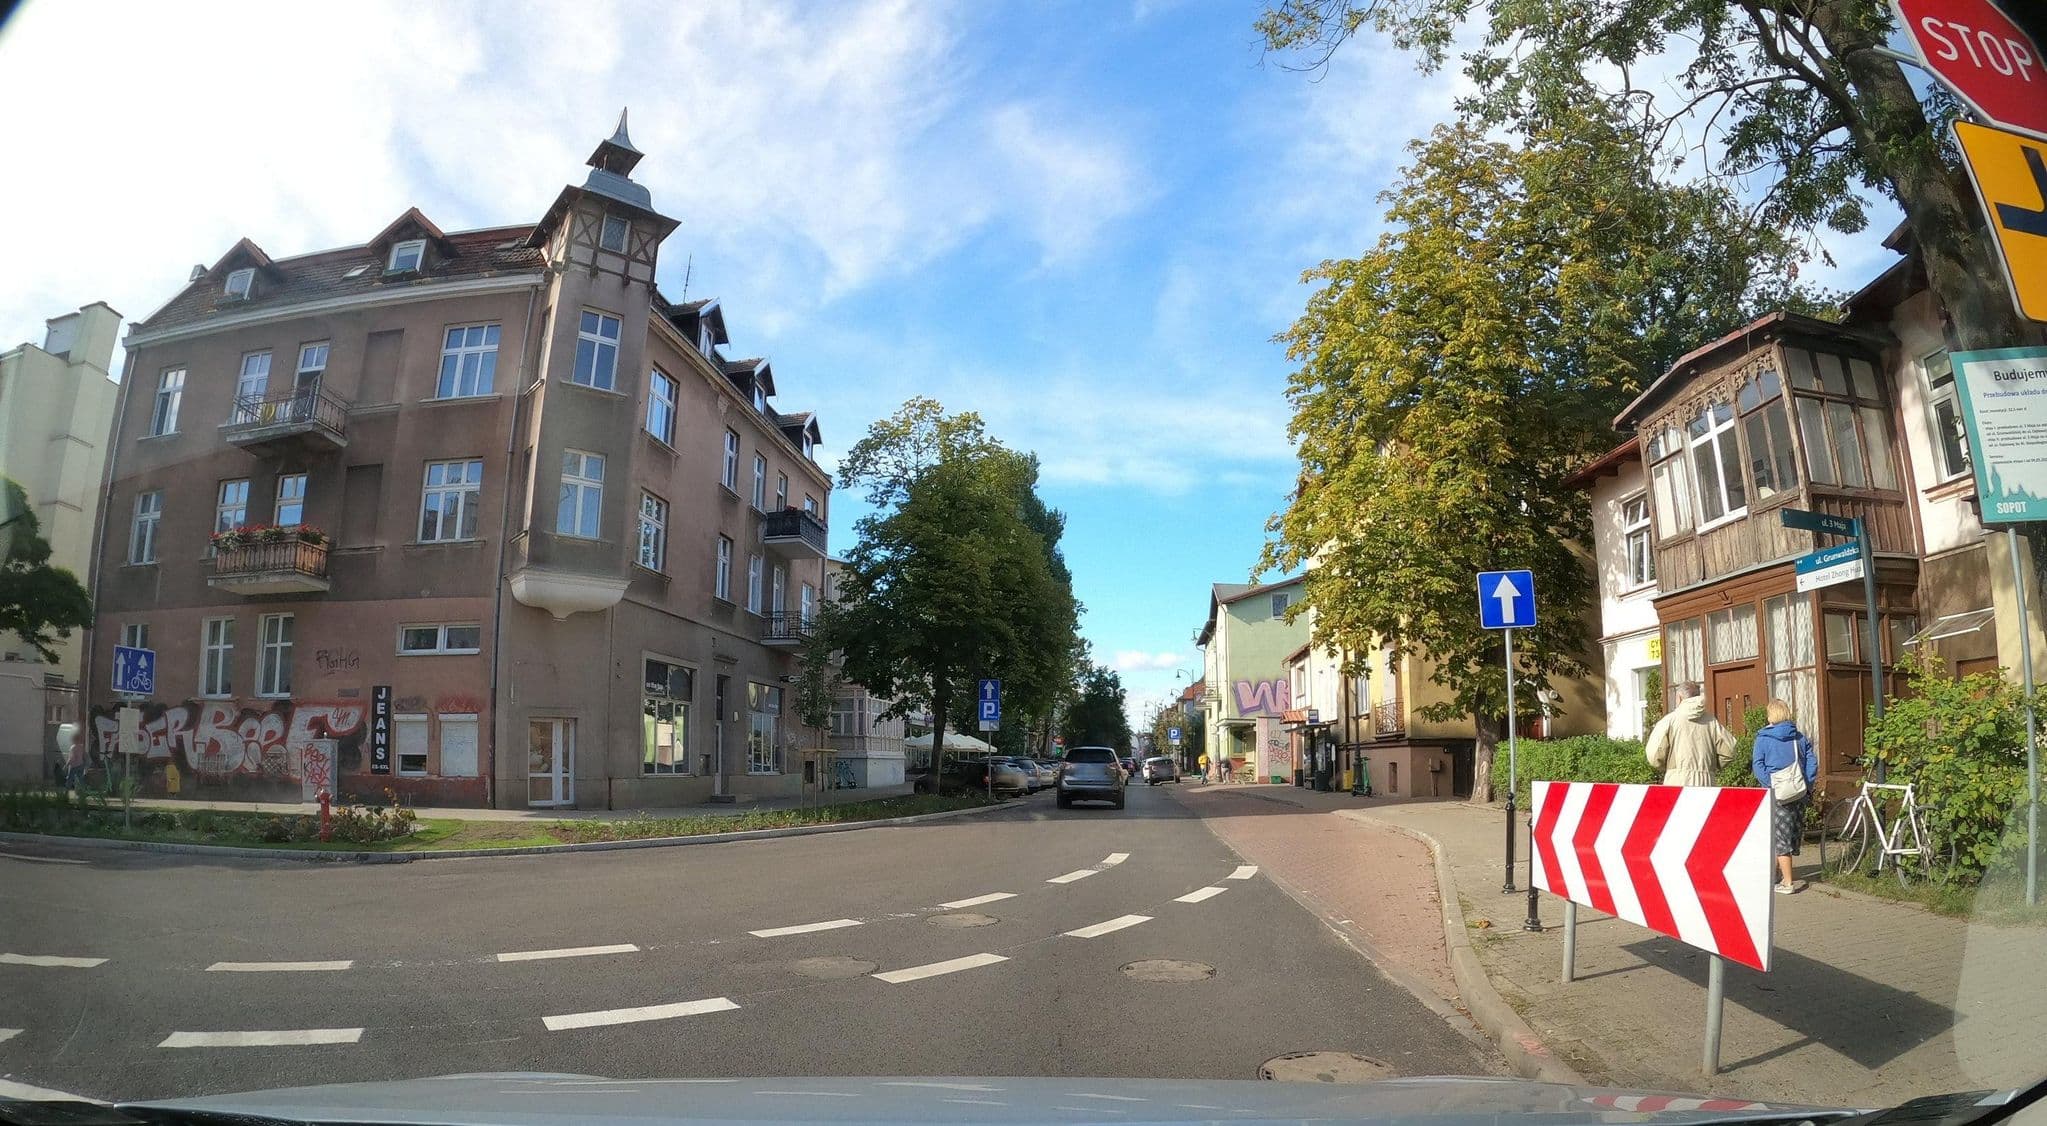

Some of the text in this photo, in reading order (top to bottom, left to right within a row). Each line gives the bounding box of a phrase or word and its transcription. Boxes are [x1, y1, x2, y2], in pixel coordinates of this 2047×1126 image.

[1921, 16, 2033, 82] STOP
[1996, 501, 2027, 514] SOPOT
[1834, 520, 1847, 531] Maja
[1815, 556, 1823, 565] ul.
[983, 702, 995, 718] P
[375, 687, 386, 760] JEANS
